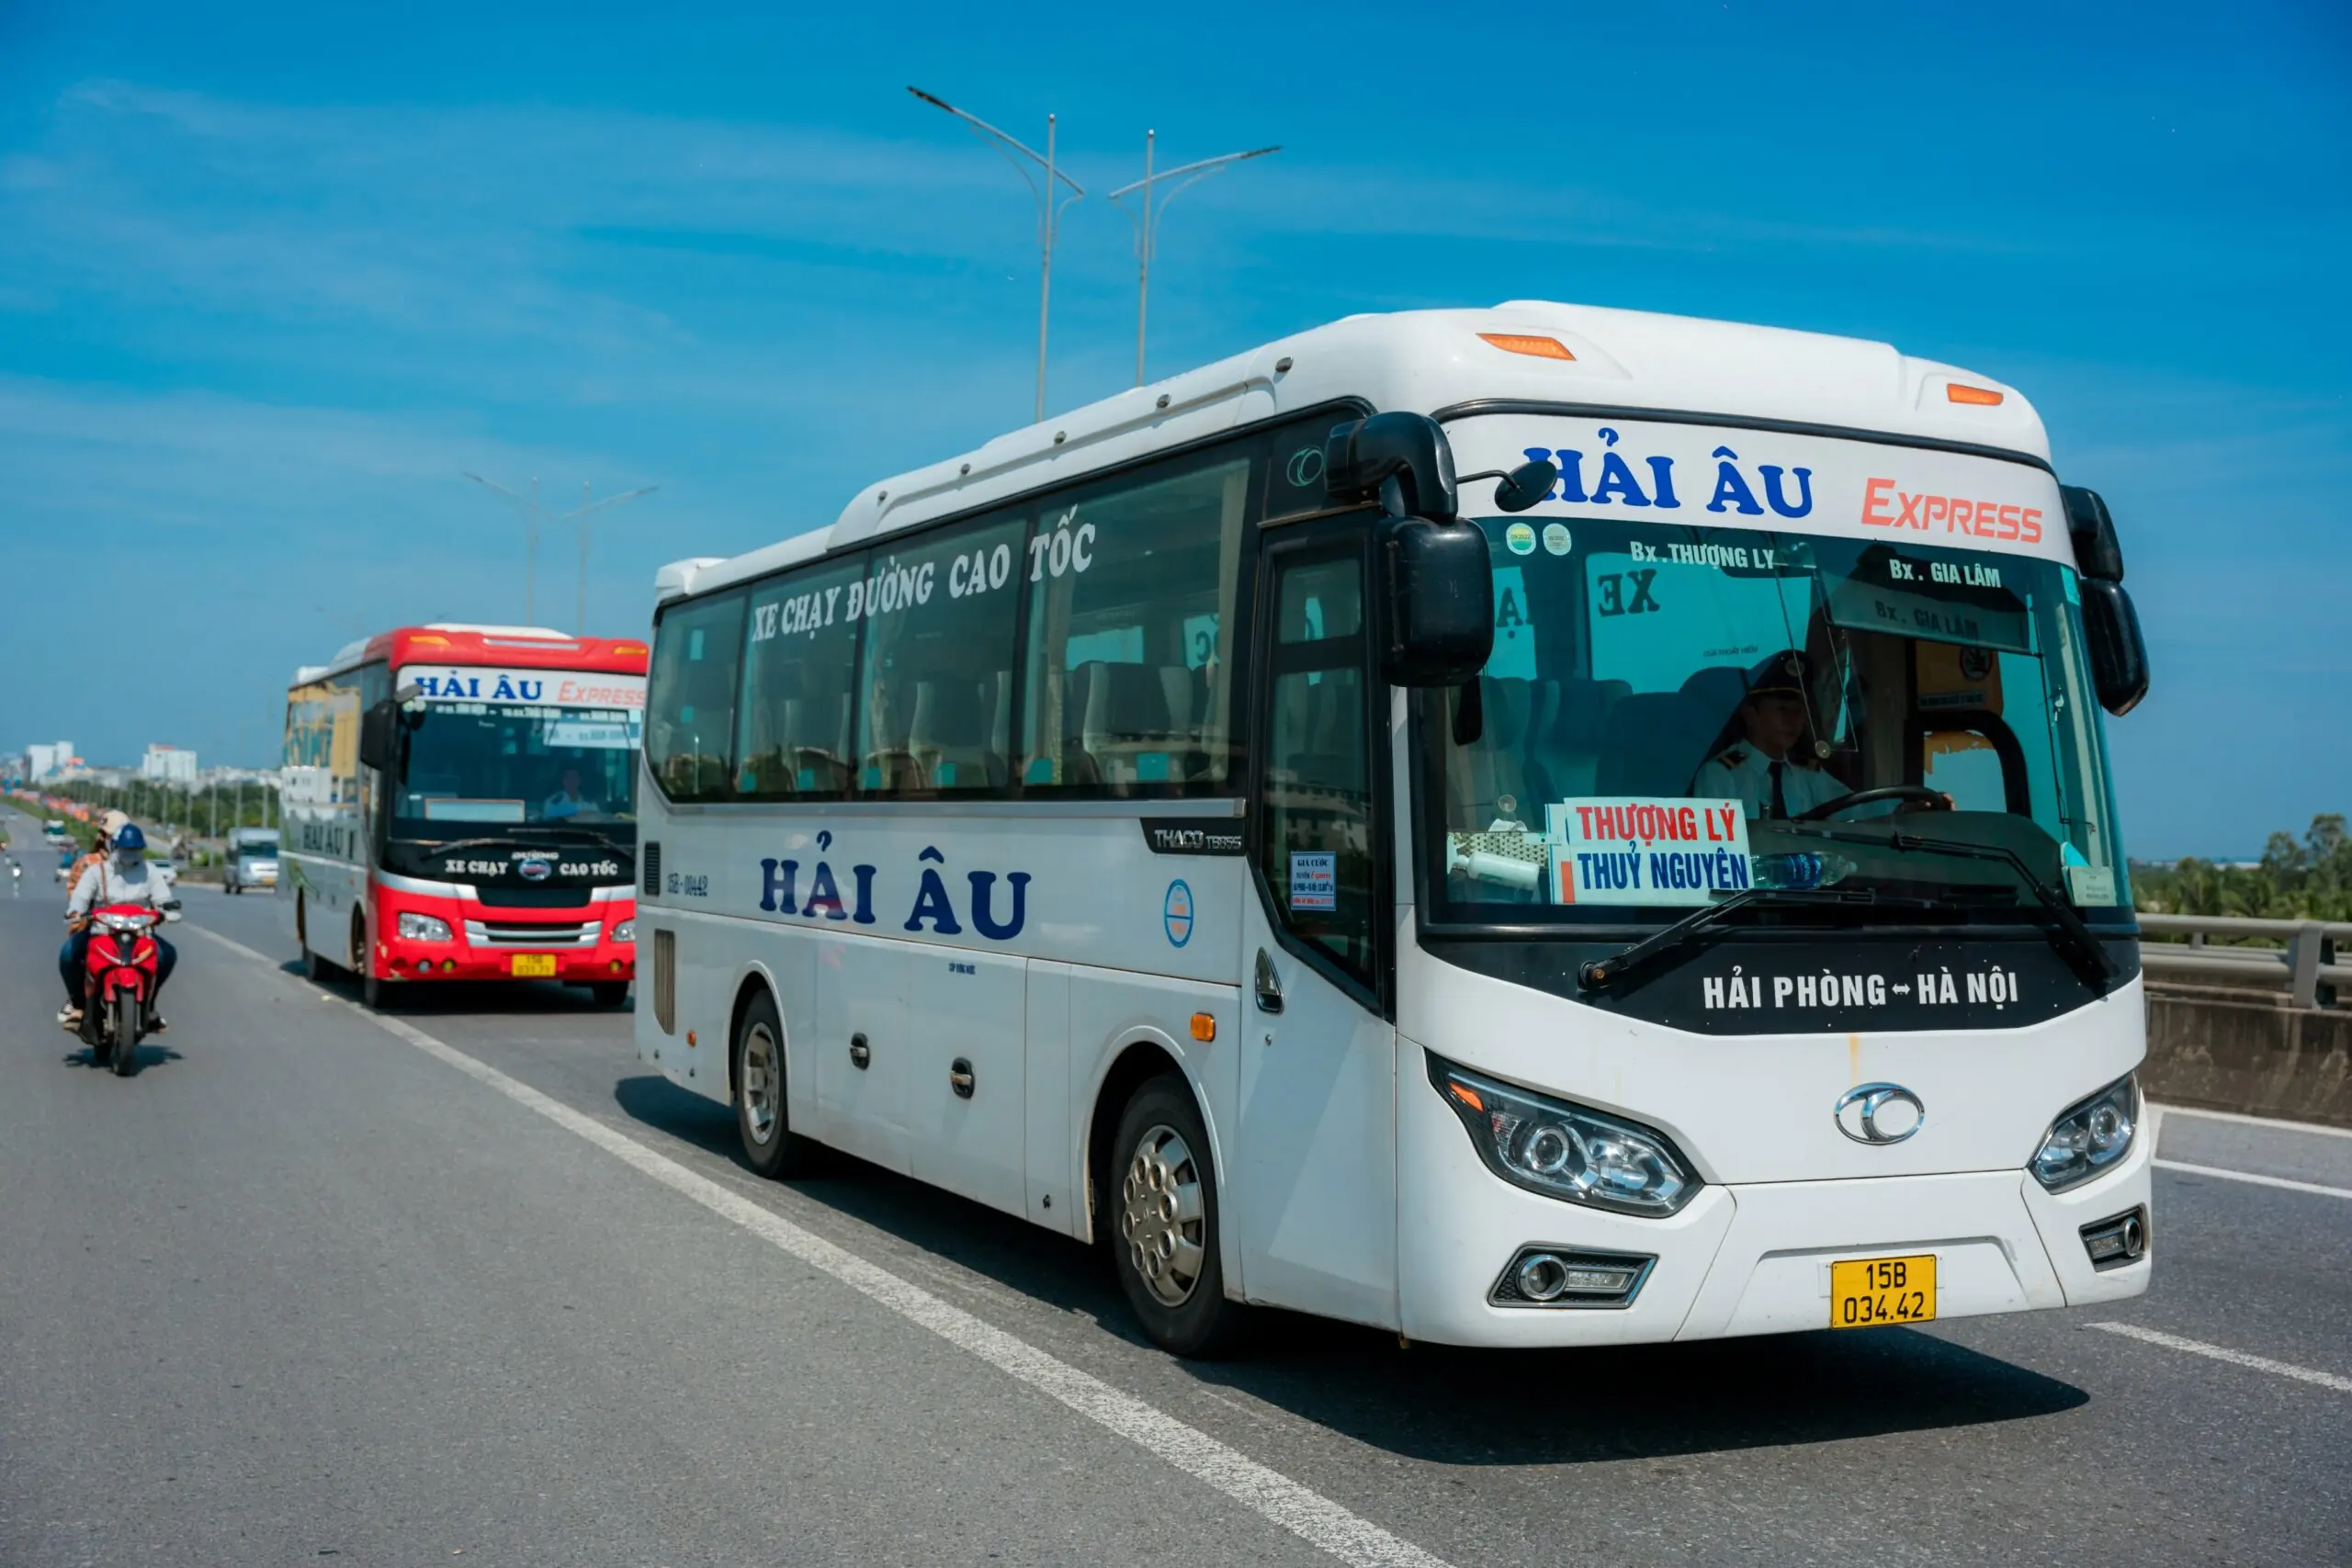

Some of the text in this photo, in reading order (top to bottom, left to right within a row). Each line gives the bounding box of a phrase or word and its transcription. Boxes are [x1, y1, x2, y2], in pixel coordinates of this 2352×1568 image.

[1522, 427, 1813, 518] HẢI ÂU
[752, 503, 1096, 641] XE CHẠY ĐƯỜNG CAO TỐC
[1668, 543, 1748, 570] THƯỢNG
[1752, 548, 1774, 570] LY
[1930, 562, 1962, 584] GIA
[1963, 562, 2002, 588] LÂM
[414, 670, 480, 698] HẢI
[492, 673, 543, 700] ÂU
[1154, 829, 1204, 849] THACO
[1576, 802, 1736, 847] THƯỢNG LÝ
[445, 860, 466, 873] XE
[559, 863, 589, 875] CAO
[1649, 847, 1749, 889] NGUYÊN
[759, 830, 1032, 941] HẢI ÂU
[1702, 965, 2018, 1010] HẢI PHÒNG HÀ NỘI
[1866, 1261, 1906, 1290] 15B
[1843, 1291, 1925, 1324] 034.42
